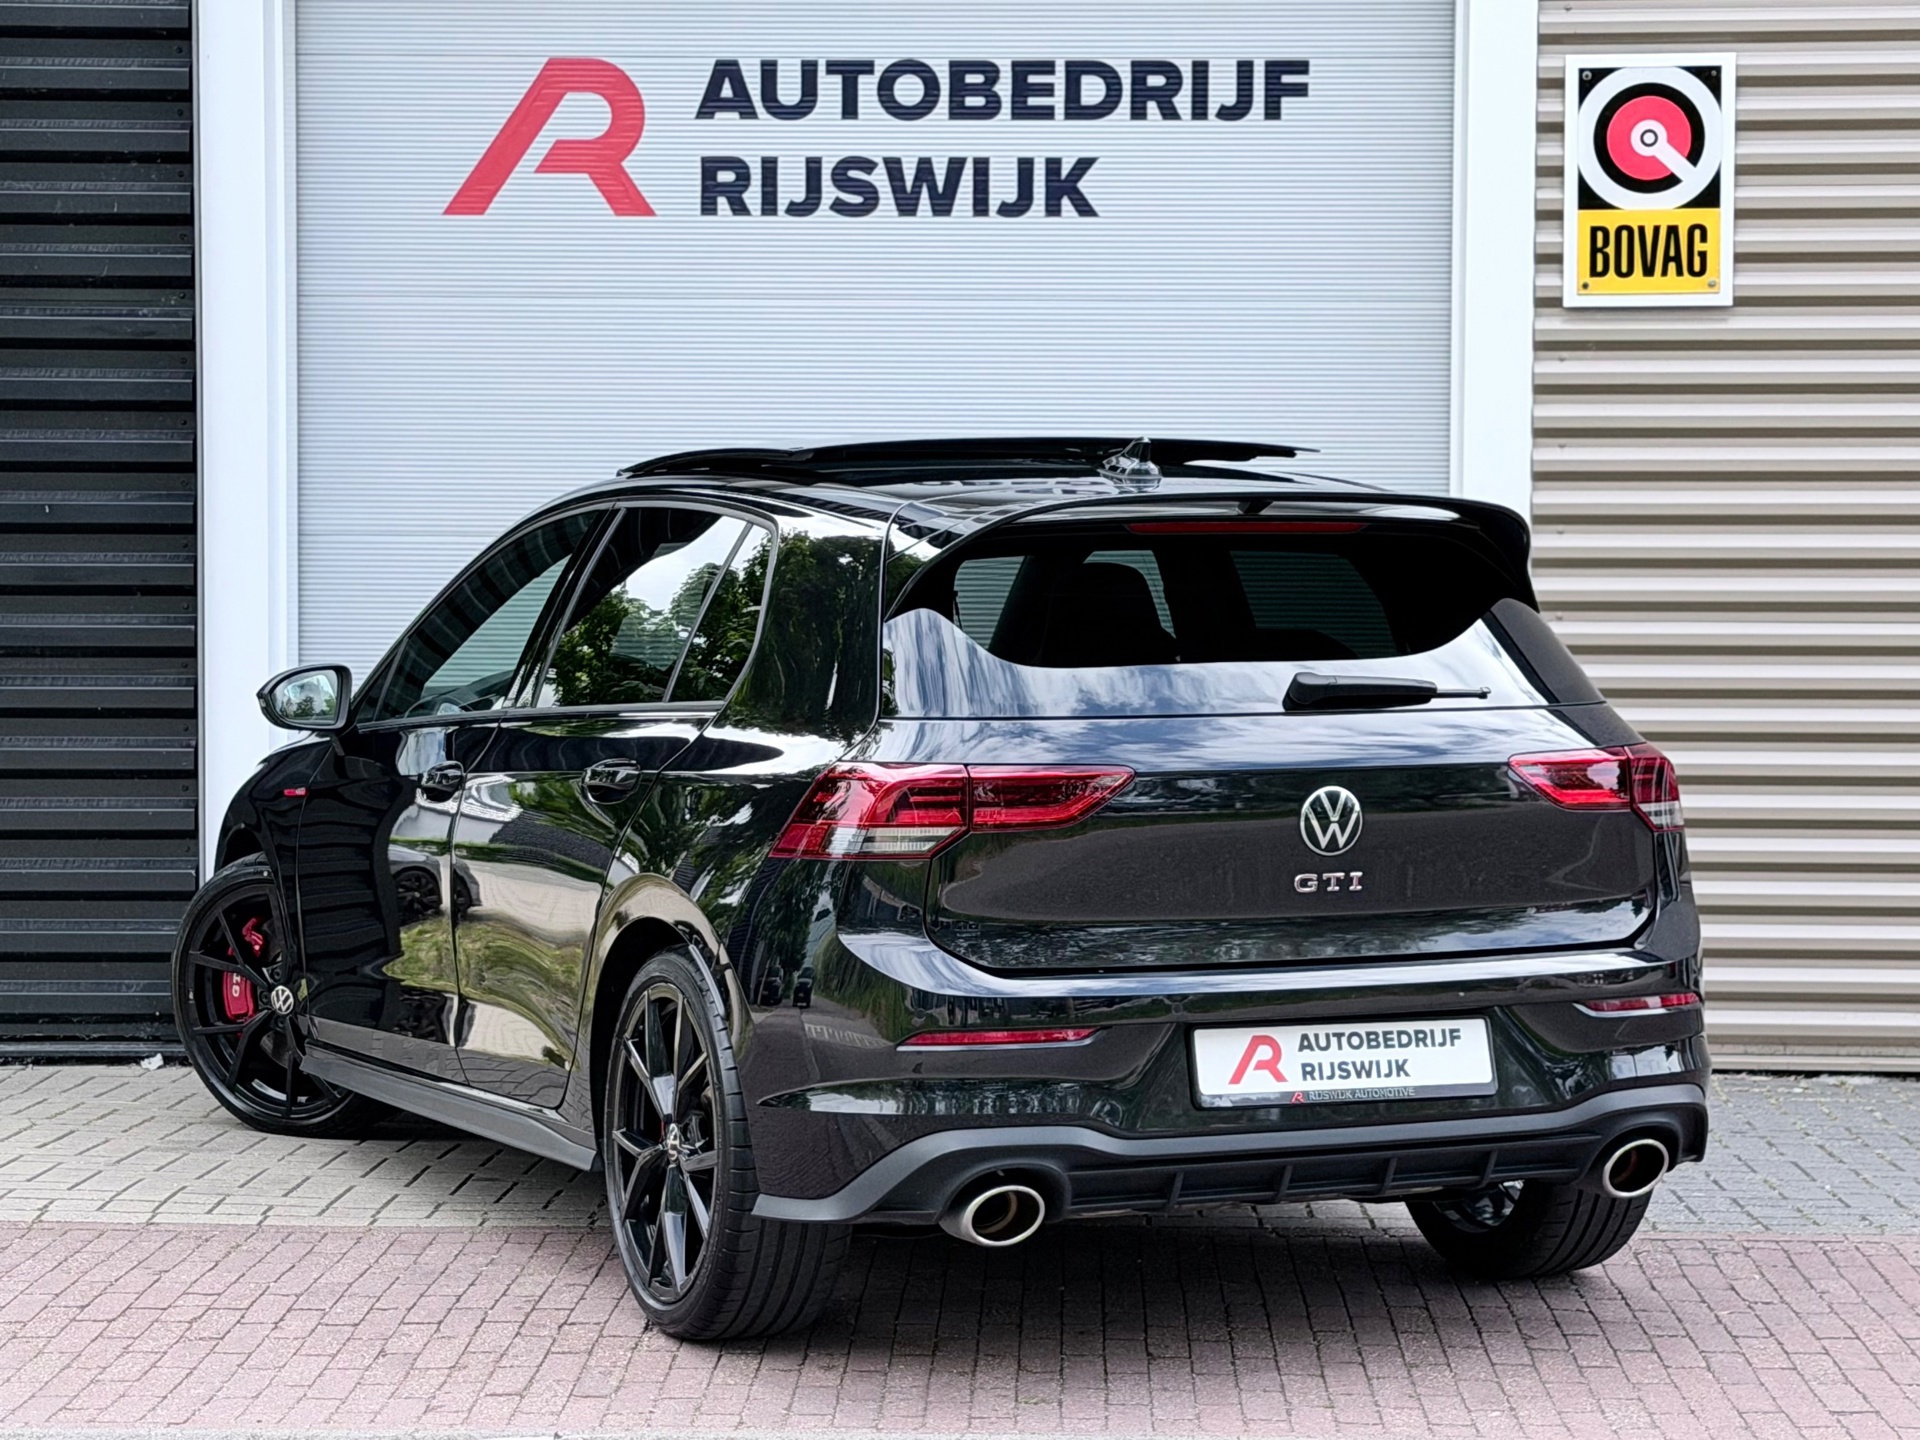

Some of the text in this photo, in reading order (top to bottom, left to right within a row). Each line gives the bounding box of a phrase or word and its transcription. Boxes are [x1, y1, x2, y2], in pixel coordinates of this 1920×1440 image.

[695, 59, 1310, 121] AUTOBEDRIJF
[700, 155, 1099, 218] RIJSWIJK
[1589, 223, 1708, 279] BOVAG
[1294, 871, 1363, 893] GTI
[1297, 1028, 1461, 1053] AUTOBEDRIJF
[1300, 1058, 1411, 1082] RIJSWIJK
[1309, 1087, 1415, 1101] RIJSWIJK AUTOMOTIVE
